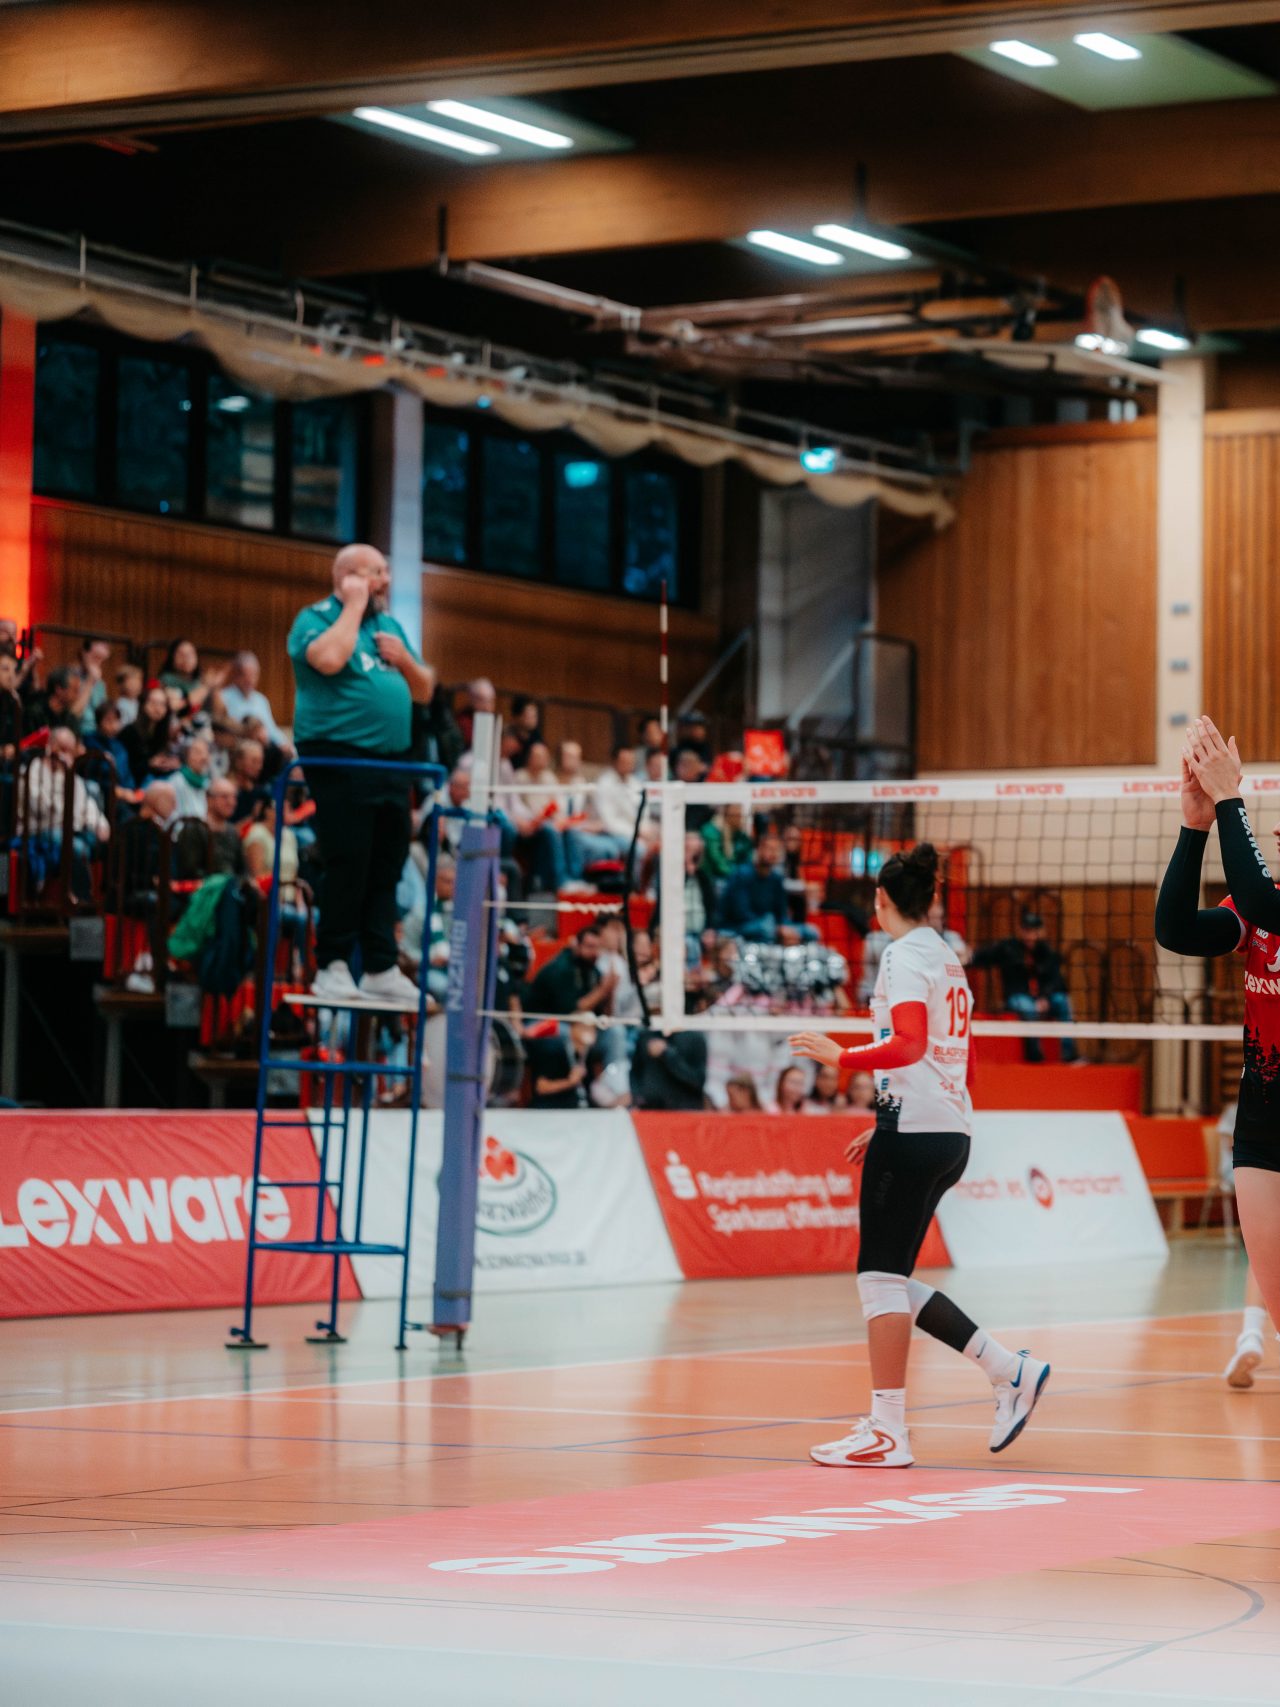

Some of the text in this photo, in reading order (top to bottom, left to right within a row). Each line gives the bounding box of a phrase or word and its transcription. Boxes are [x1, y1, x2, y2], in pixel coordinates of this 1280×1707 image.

[1238, 806, 1273, 879] Lexware
[944, 986, 968, 1039] 19
[427, 1482, 1145, 1576] Lexware
